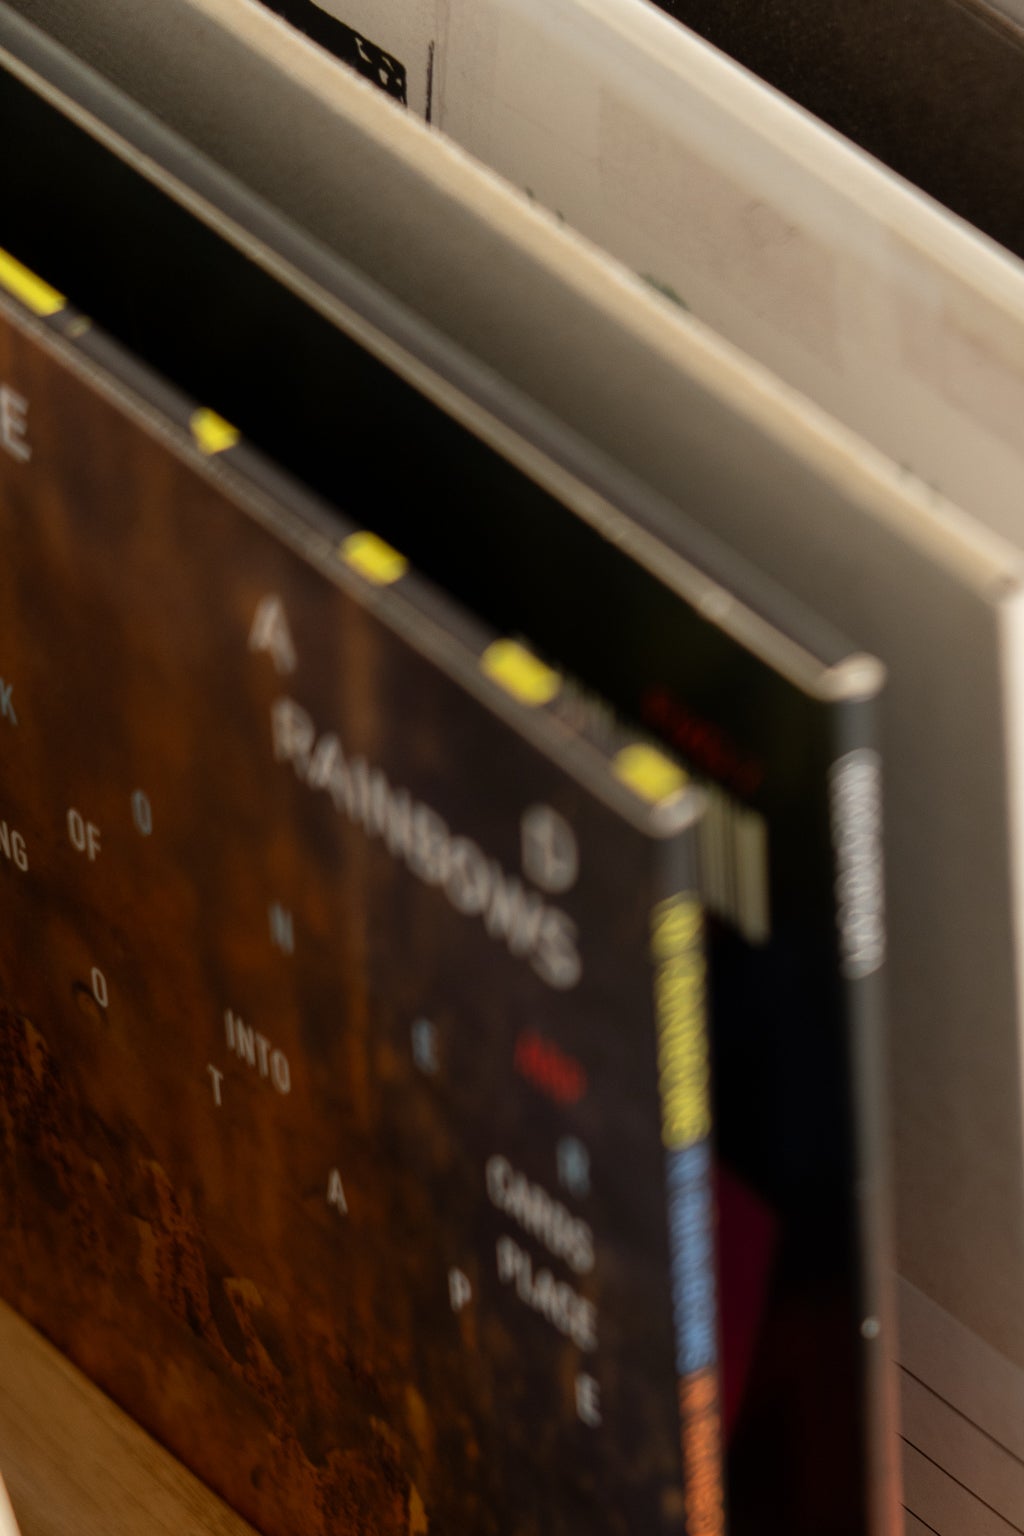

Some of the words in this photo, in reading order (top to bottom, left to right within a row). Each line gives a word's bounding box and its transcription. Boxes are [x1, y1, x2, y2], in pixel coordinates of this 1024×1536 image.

[248, 595, 296, 675] A
[66, 807, 101, 862] OF
[272, 697, 582, 991] RAINBOWS
[207, 1063, 223, 1106] T
[224, 1008, 291, 1095] INTO
[327, 1166, 349, 1215] A
[497, 1233, 597, 1352] PLACE
